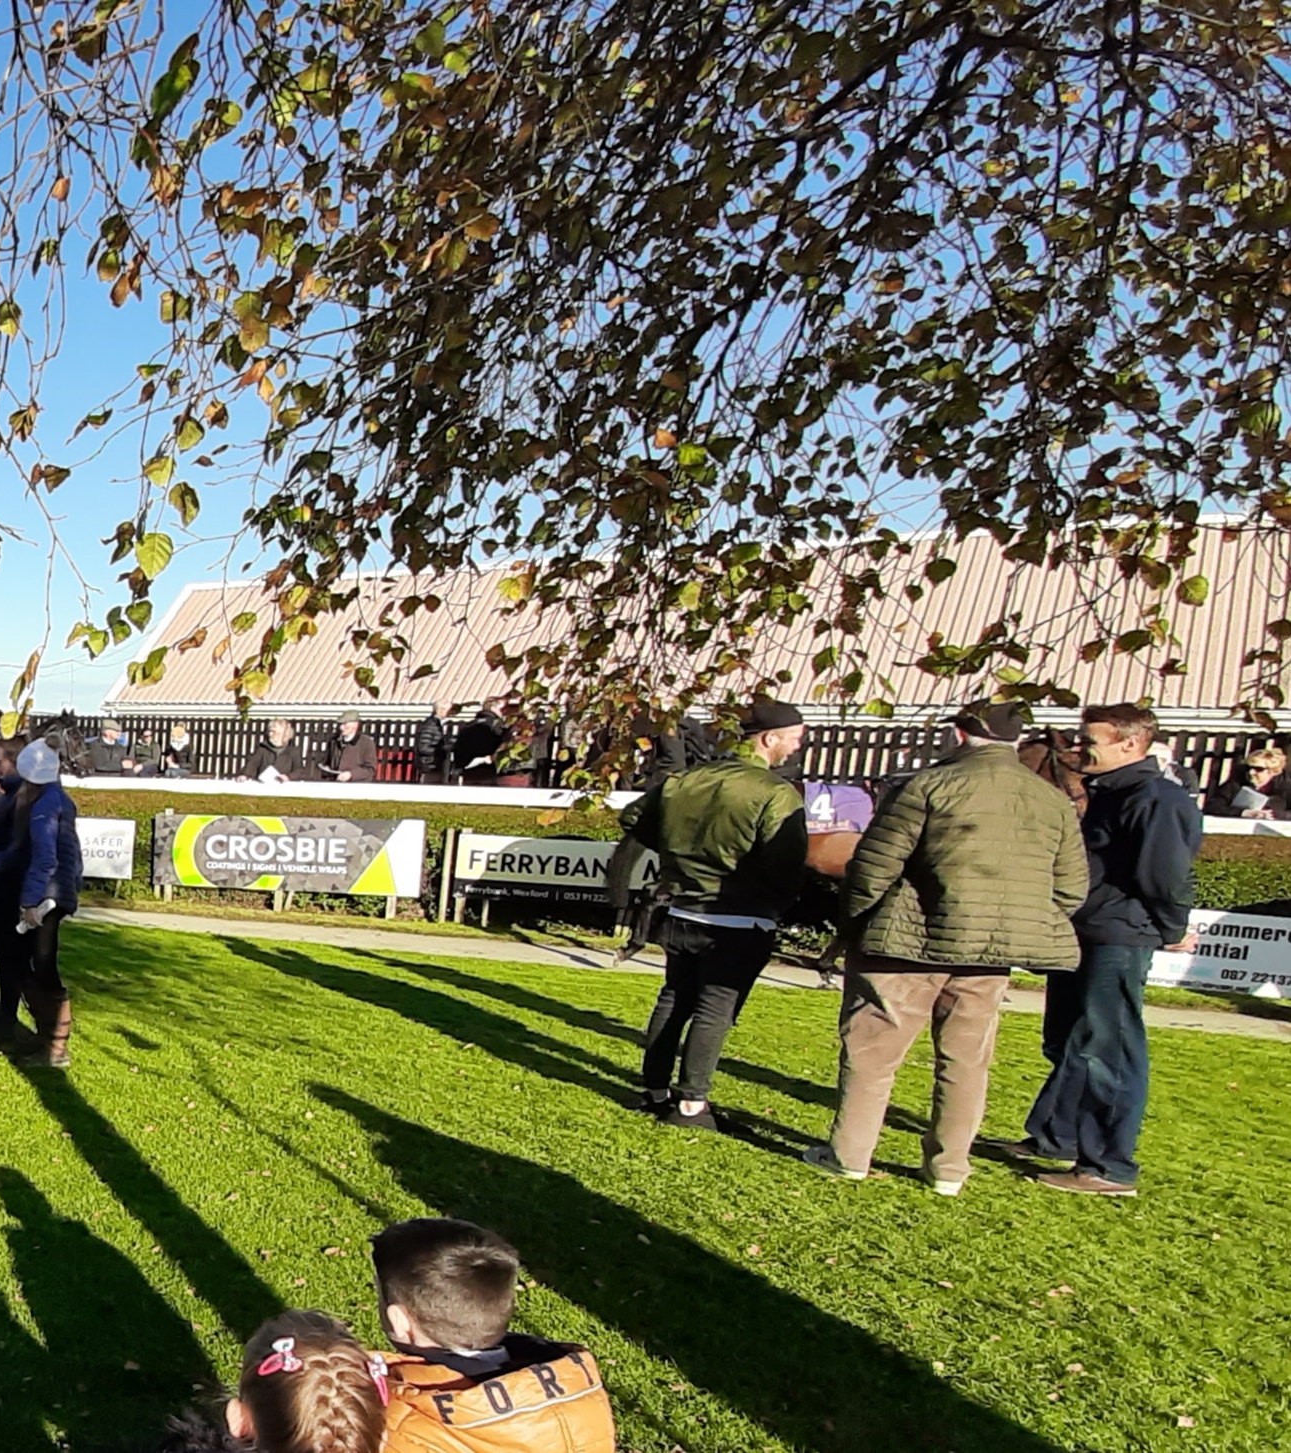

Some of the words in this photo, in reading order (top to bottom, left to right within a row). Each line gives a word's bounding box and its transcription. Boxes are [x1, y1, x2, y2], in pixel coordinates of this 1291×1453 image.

[809, 793, 836, 821] 4
[84, 836, 124, 848] SAFER
[205, 834, 348, 864] CROSBIE
[81, 848, 123, 859] OLOGY
[205, 861, 246, 871] COATINGS
[251, 863, 277, 873] SIGNS
[282, 864, 317, 874] VEHICLE
[318, 865, 348, 875] WRAPS
[468, 849, 611, 879] FERRYBAN
[512, 888, 550, 899] Wexford
[1192, 943, 1250, 960] ntial
[1220, 968, 1248, 981] 087
